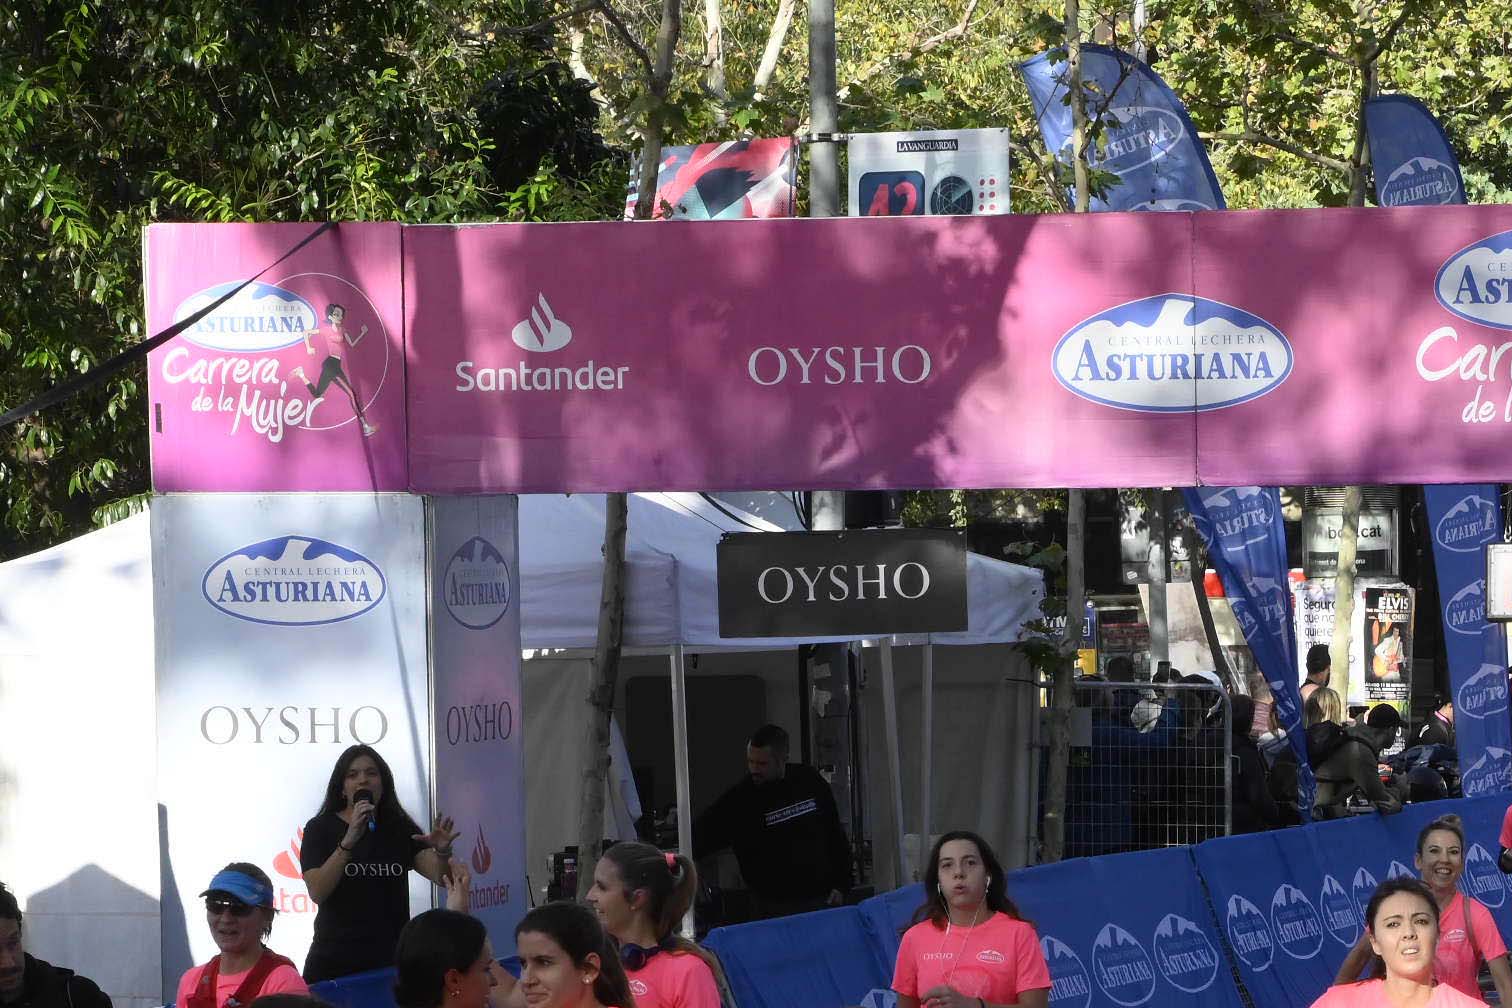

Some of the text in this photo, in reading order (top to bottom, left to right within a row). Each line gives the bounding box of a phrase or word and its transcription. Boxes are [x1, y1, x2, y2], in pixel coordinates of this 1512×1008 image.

[1108, 334, 1266, 346] CENTRAL LECHERA
[161, 347, 280, 385] Carrera
[455, 360, 630, 392] Santander
[747, 345, 931, 386] OYSHO
[1071, 339, 1274, 382] ASTURIANA
[191, 381, 325, 443] de la Mujer
[1461, 383, 1497, 423] de
[218, 569, 373, 603] ASTURIANA
[244, 566, 366, 577] CENTRAL LECHERA
[758, 562, 930, 604] OYSHO
[200, 705, 388, 745] OYSHO
[446, 700, 512, 746] OYSHO
[344, 862, 403, 877] OYSHO
